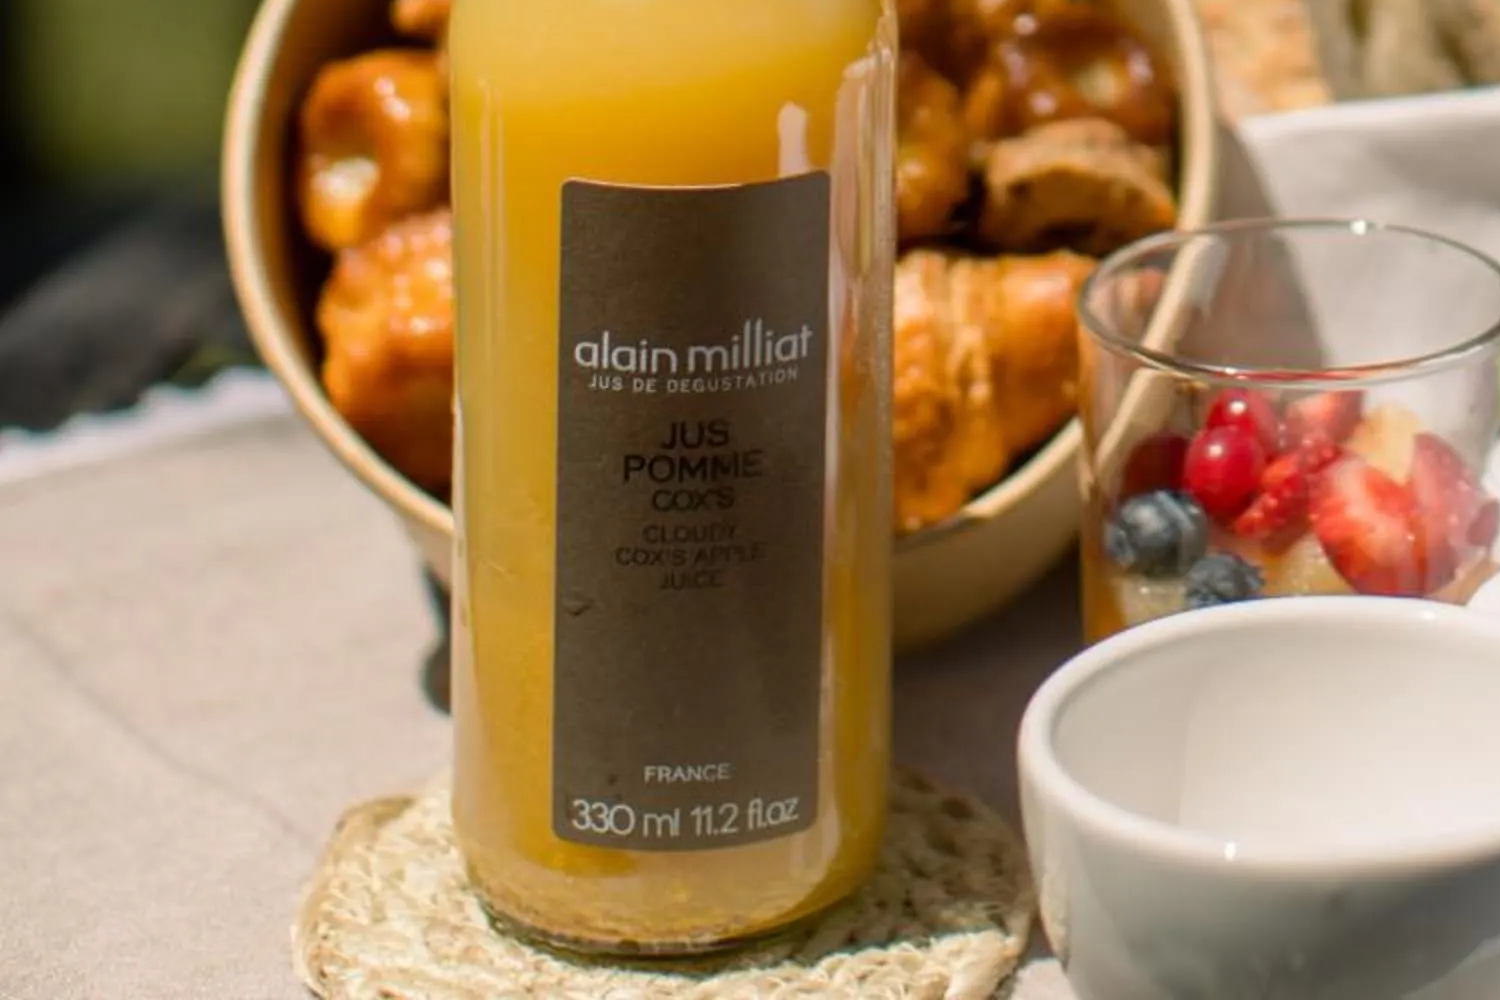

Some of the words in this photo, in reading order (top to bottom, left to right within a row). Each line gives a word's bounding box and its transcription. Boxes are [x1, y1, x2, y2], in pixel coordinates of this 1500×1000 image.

[574, 330, 677, 373] alain
[688, 317, 813, 373] milliat
[590, 374, 623, 391] JUS
[633, 377, 658, 393] DE
[667, 365, 799, 393] DEGUSTATION
[660, 419, 730, 449] JUS
[623, 448, 765, 485] POMME
[642, 522, 738, 544] CLOUDY
[694, 541, 768, 565] APPLE
[659, 569, 723, 591] JUICE
[644, 763, 731, 783] FRANCE
[572, 799, 636, 836] 330
[643, 808, 681, 838] ml
[690, 803, 740, 837] 11.2
